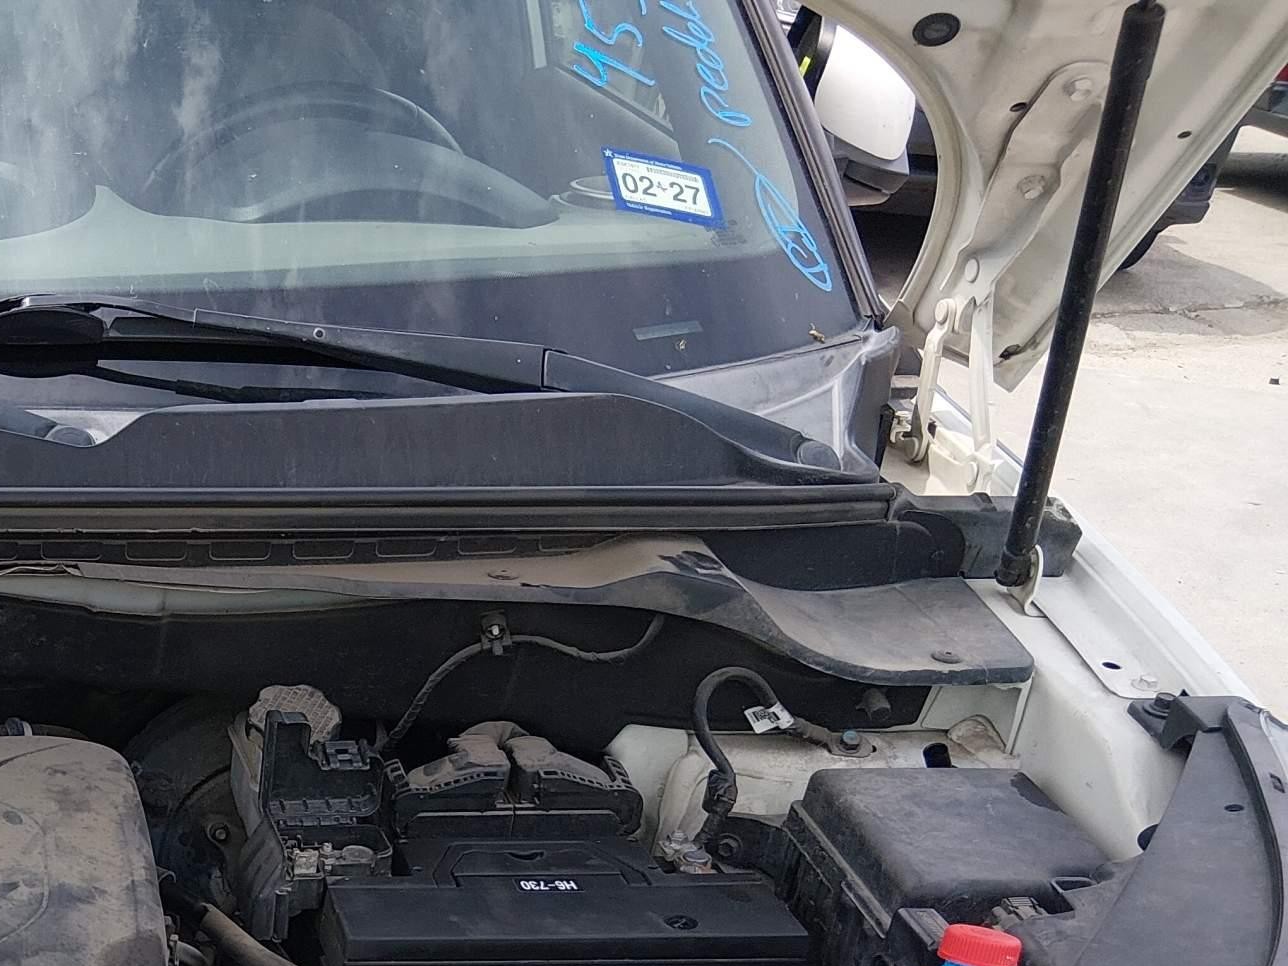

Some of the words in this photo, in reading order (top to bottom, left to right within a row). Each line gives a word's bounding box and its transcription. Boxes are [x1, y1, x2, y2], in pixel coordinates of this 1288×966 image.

[621, 172, 657, 198] 02
[668, 181, 700, 205] 27
[520, 881, 578, 890] H6-730
